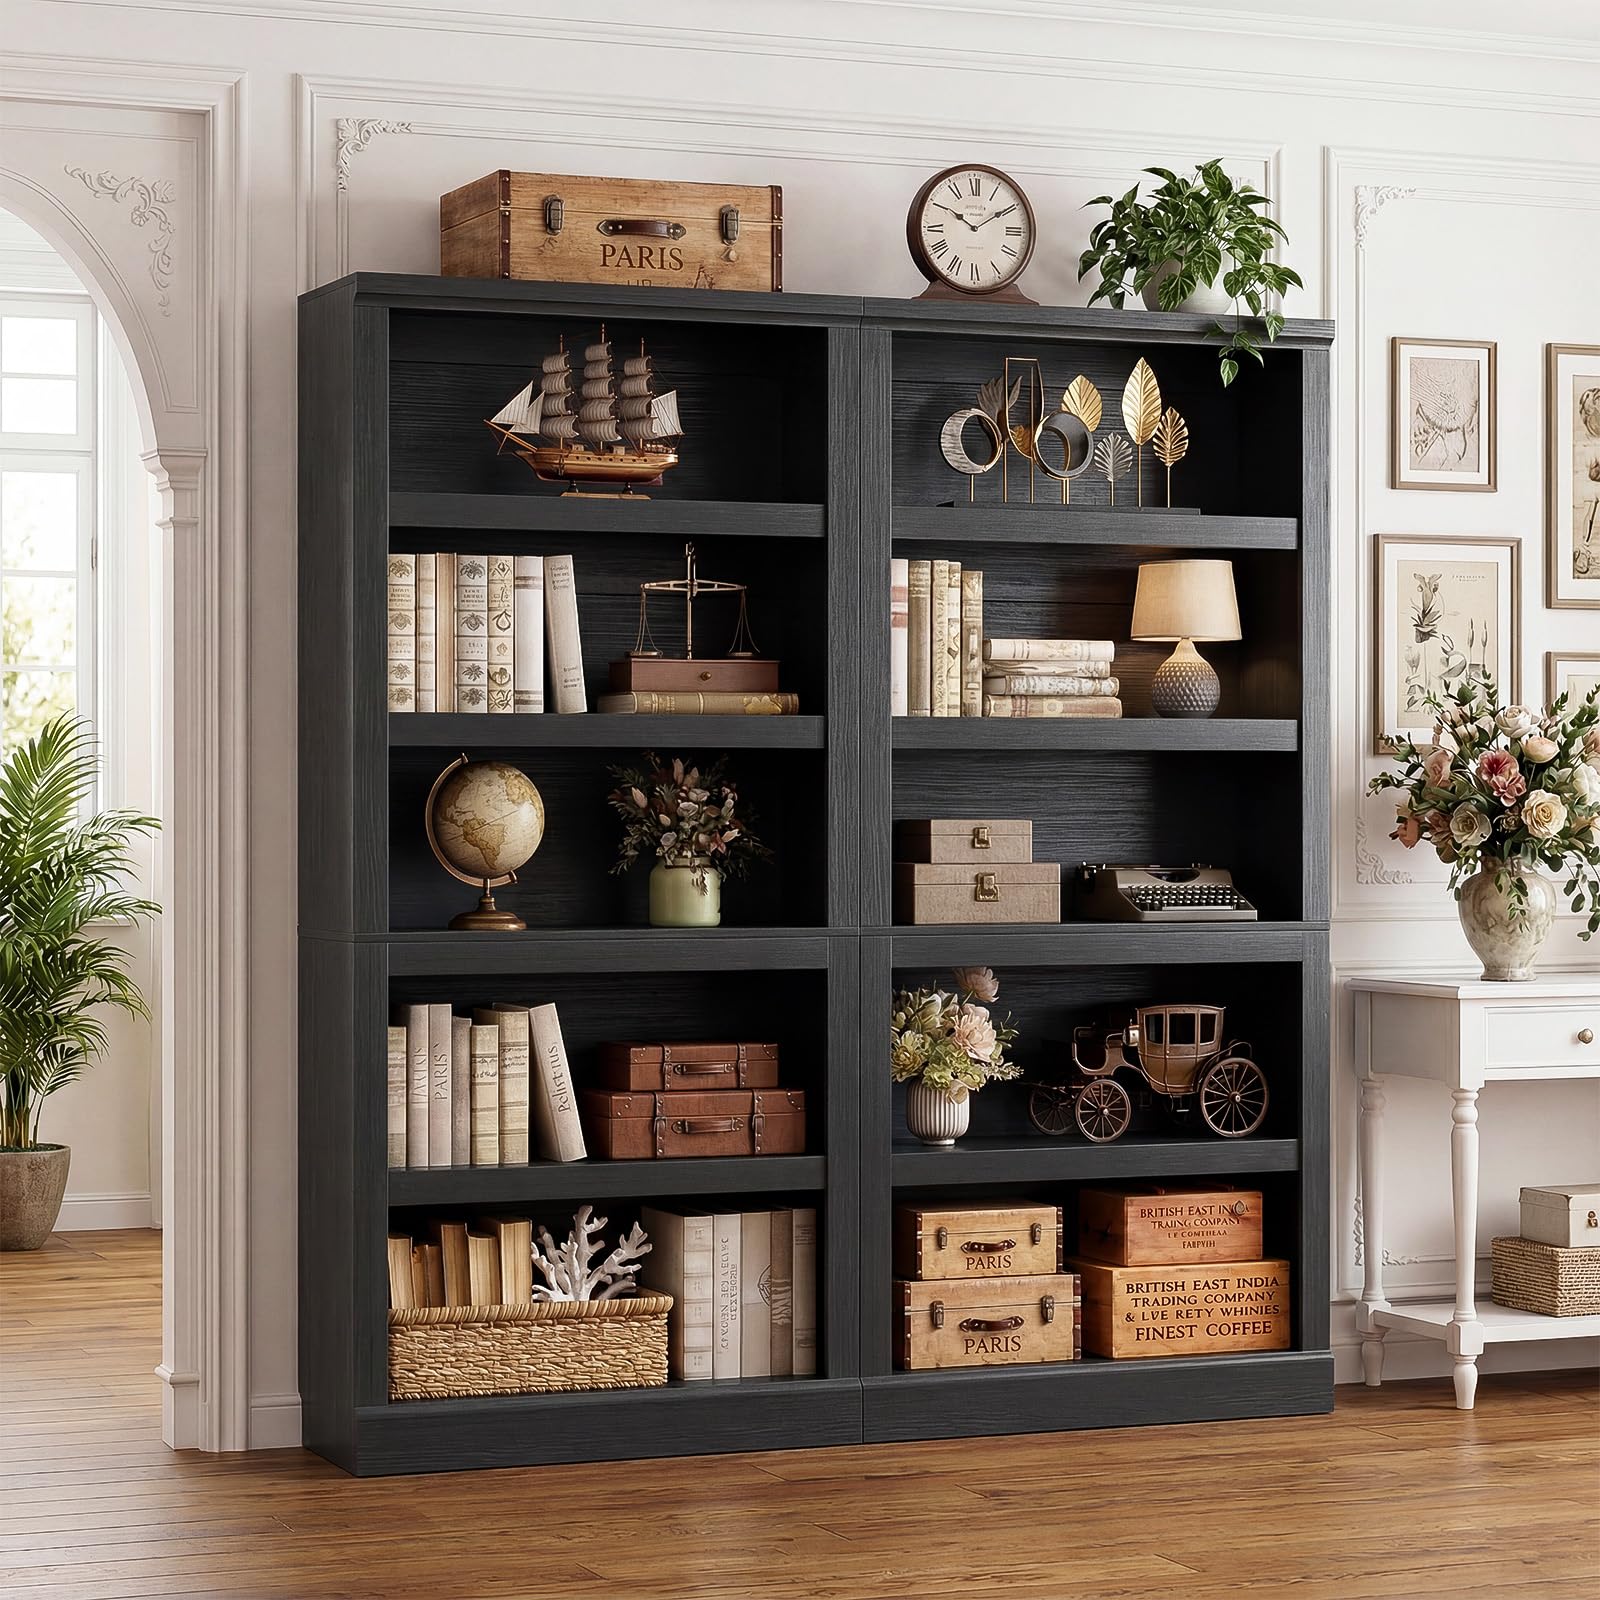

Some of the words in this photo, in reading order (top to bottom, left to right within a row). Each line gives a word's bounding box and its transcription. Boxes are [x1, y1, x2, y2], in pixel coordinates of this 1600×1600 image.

[599, 243, 684, 271] PARIS
[1140, 1206, 1184, 1219] BRITISH
[1188, 1205, 1216, 1216] EAST
[966, 1254, 1012, 1270] PARIS
[1126, 1281, 1186, 1295] BRITISH
[1193, 1279, 1231, 1291] EAST
[1236, 1276, 1280, 1289] INDIA
[1130, 1295, 1198, 1308] TRADING
[1204, 1291, 1275, 1304] COMPANY
[1125, 1312, 1136, 1323] &
[1175, 1308, 1214, 1320] RETY
[1220, 1304, 1280, 1317] WHINIES
[1135, 1324, 1198, 1342] FINEST
[1205, 1320, 1273, 1338] COFFEE
[963, 1335, 1022, 1355] PARIS
